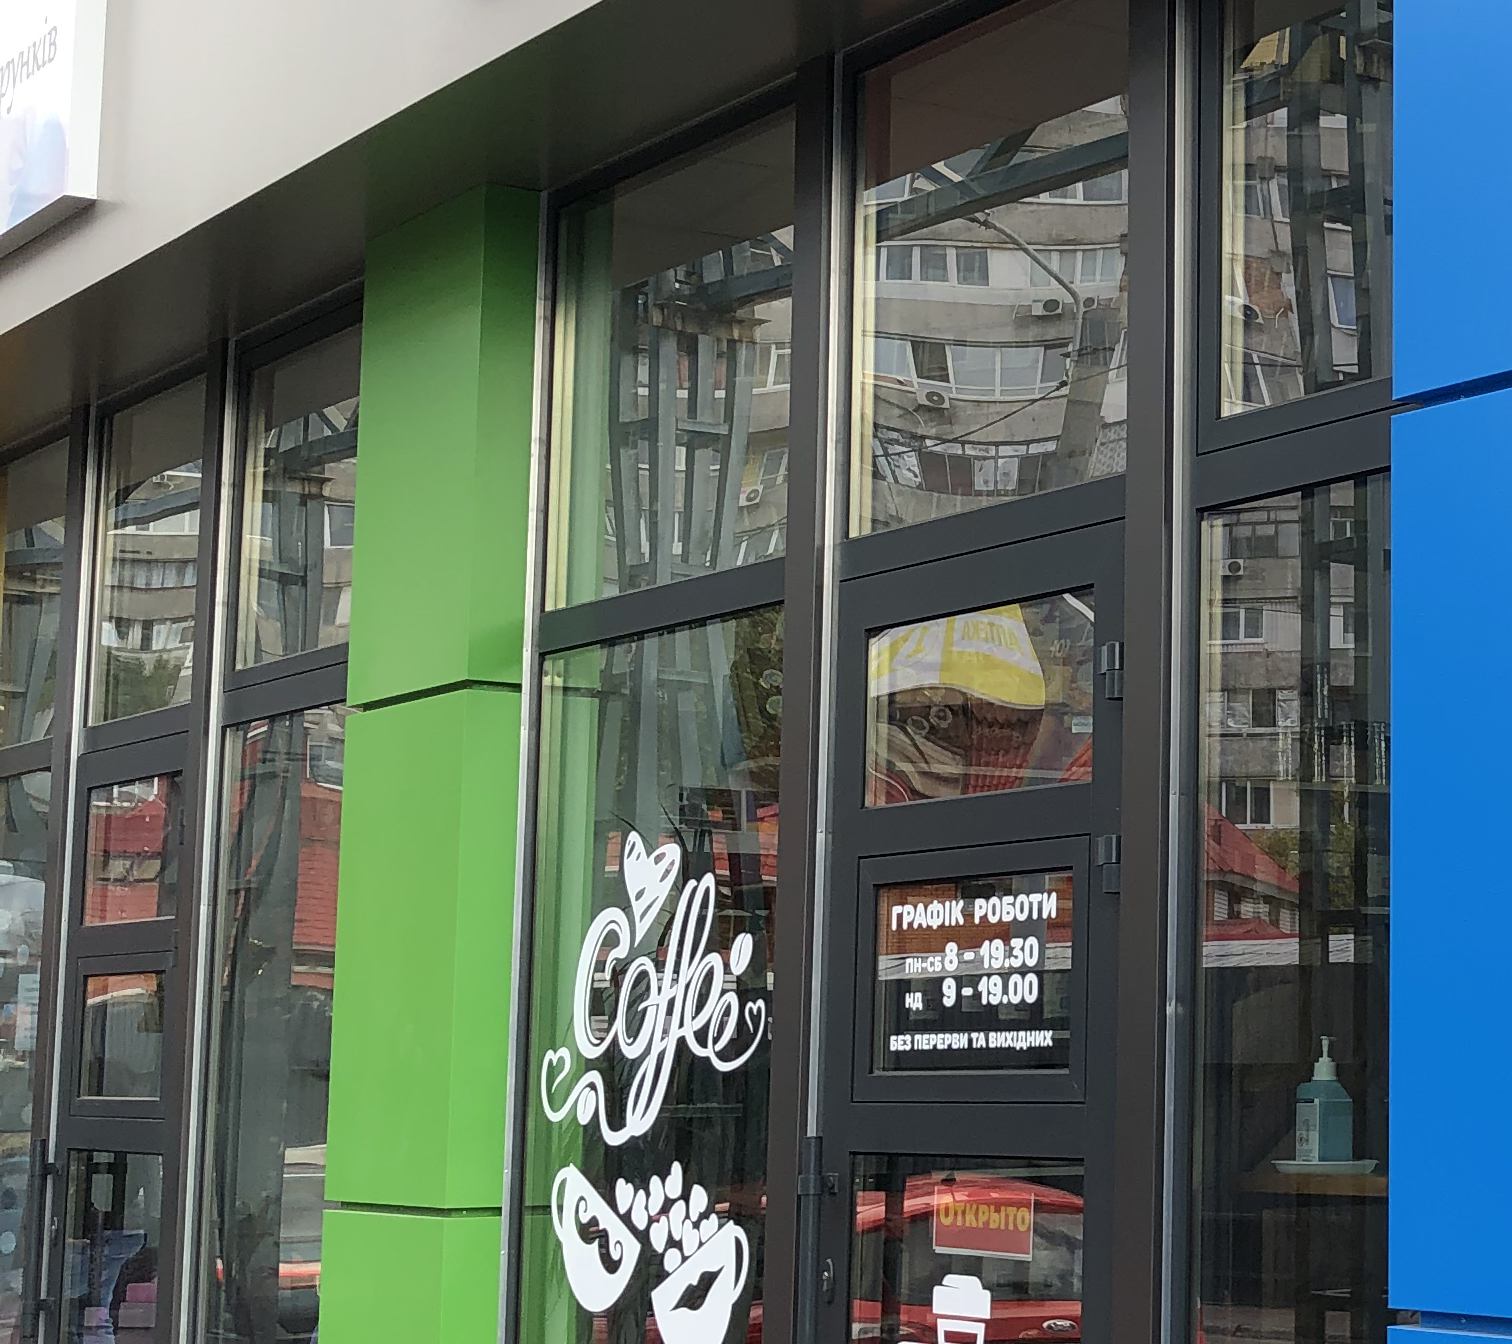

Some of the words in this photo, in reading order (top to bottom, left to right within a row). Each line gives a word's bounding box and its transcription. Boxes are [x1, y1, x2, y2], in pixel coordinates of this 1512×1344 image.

[891, 899, 964, 931] ГРАФІК
[974, 891, 1057, 925] РОБОТИ
[944, 942, 959, 972] 8
[980, 936, 1039, 969] 19.30
[942, 977, 957, 1007] 9
[977, 973, 1039, 1005] 19.00
[574, 872, 765, 1146] Coffee
[890, 1035, 911, 1051] БЕЗ
[914, 1032, 968, 1050] ПЕРЕРВИ
[971, 1032, 986, 1049] ТА
[989, 1030, 1053, 1050] ВИХІДНИХ
